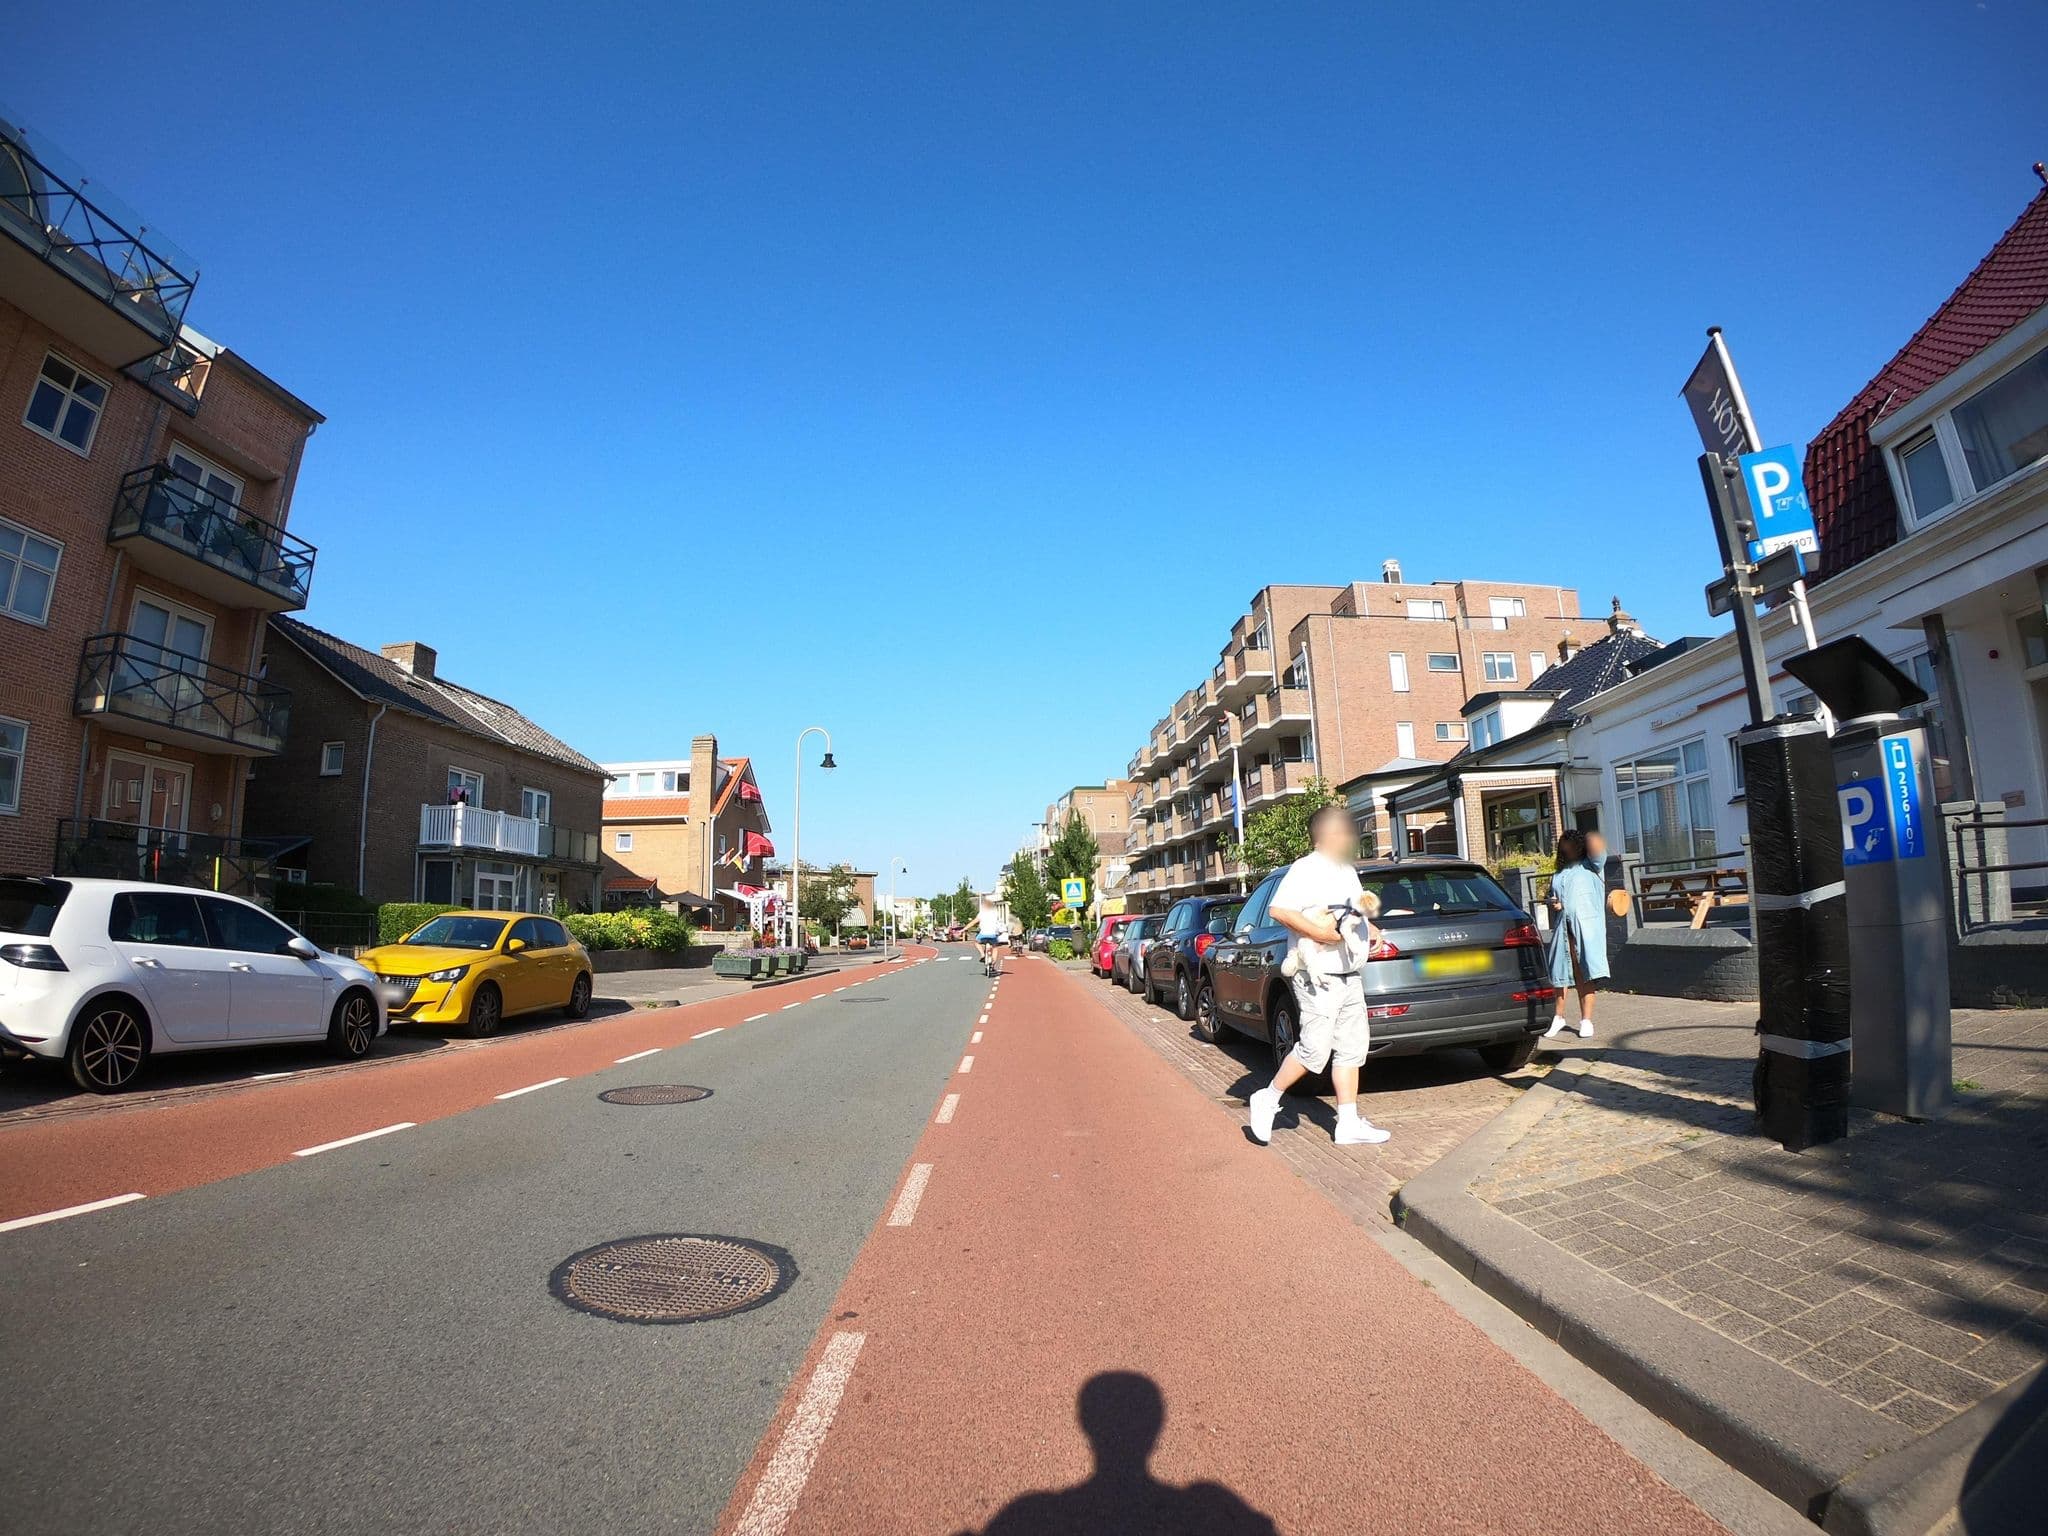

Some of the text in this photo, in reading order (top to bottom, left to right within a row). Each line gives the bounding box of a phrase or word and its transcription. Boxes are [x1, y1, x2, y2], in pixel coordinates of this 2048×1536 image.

[1708, 388, 1749, 461] HOTE
[1752, 462, 1790, 518] P
[1838, 786, 1874, 850] P
[1897, 771, 1915, 854] 236107
